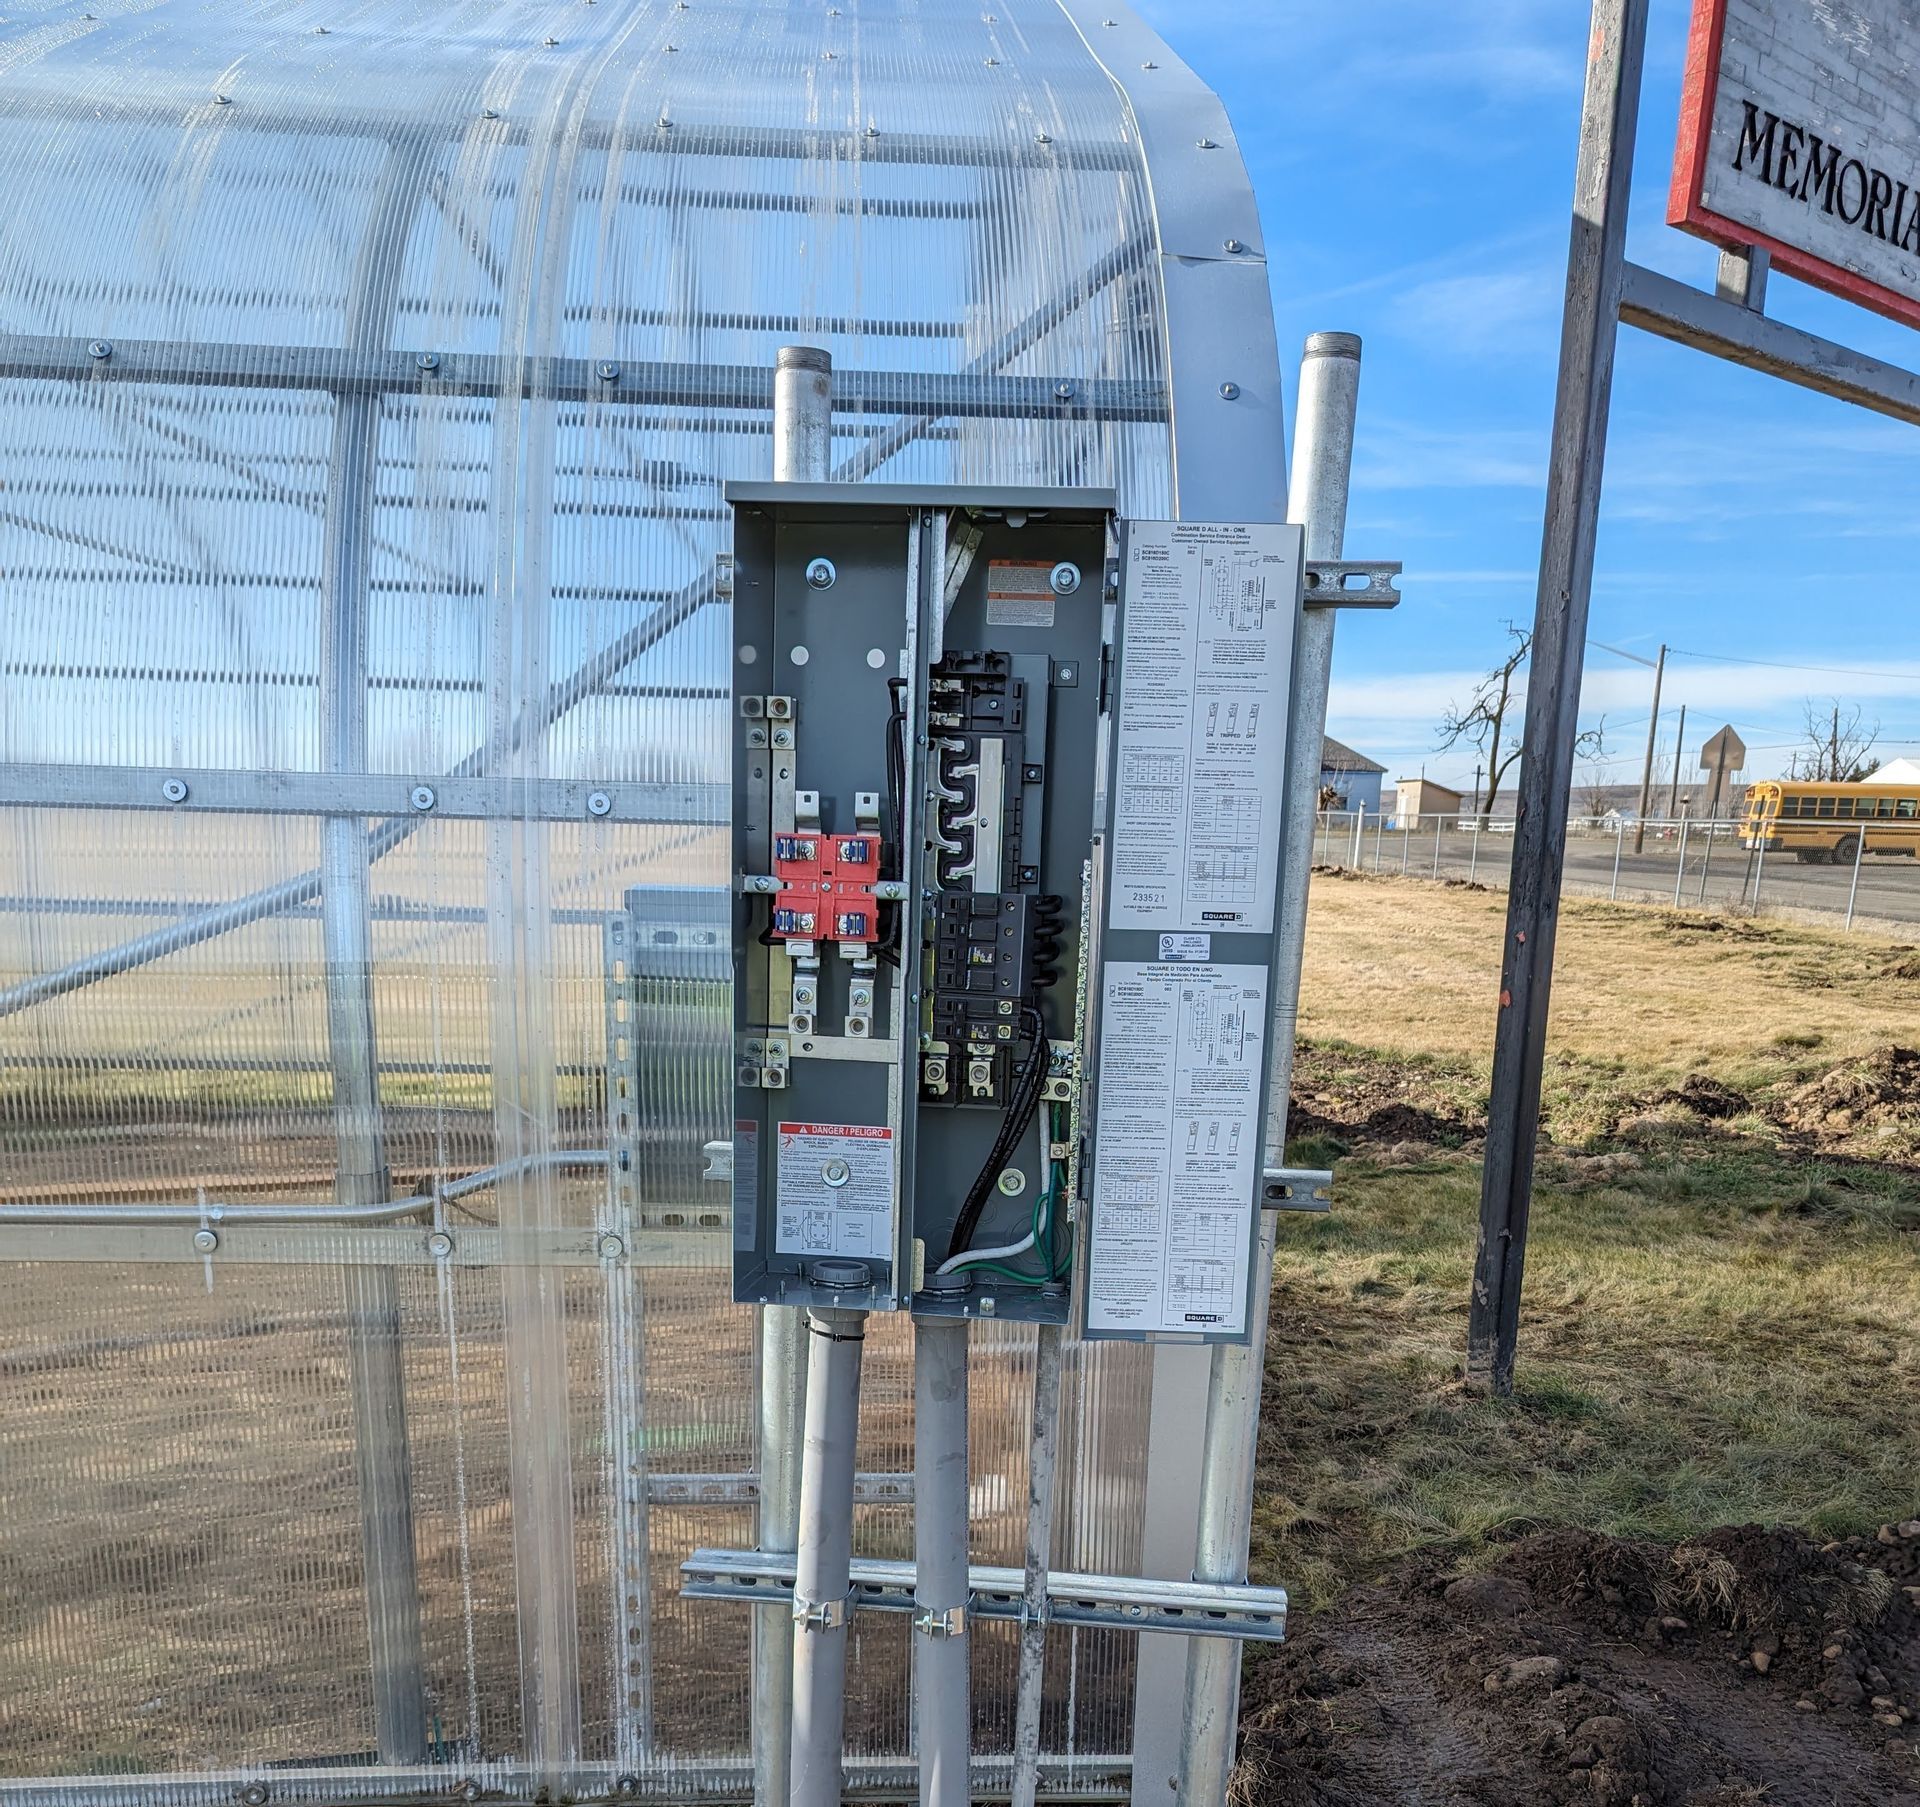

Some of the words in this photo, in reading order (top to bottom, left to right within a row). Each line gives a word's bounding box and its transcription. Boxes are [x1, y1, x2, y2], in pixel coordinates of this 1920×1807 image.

[1133, 892, 1164, 902] 233521
[812, 1126, 844, 1135] DANGER
[849, 1128, 884, 1137] PELIGRO
